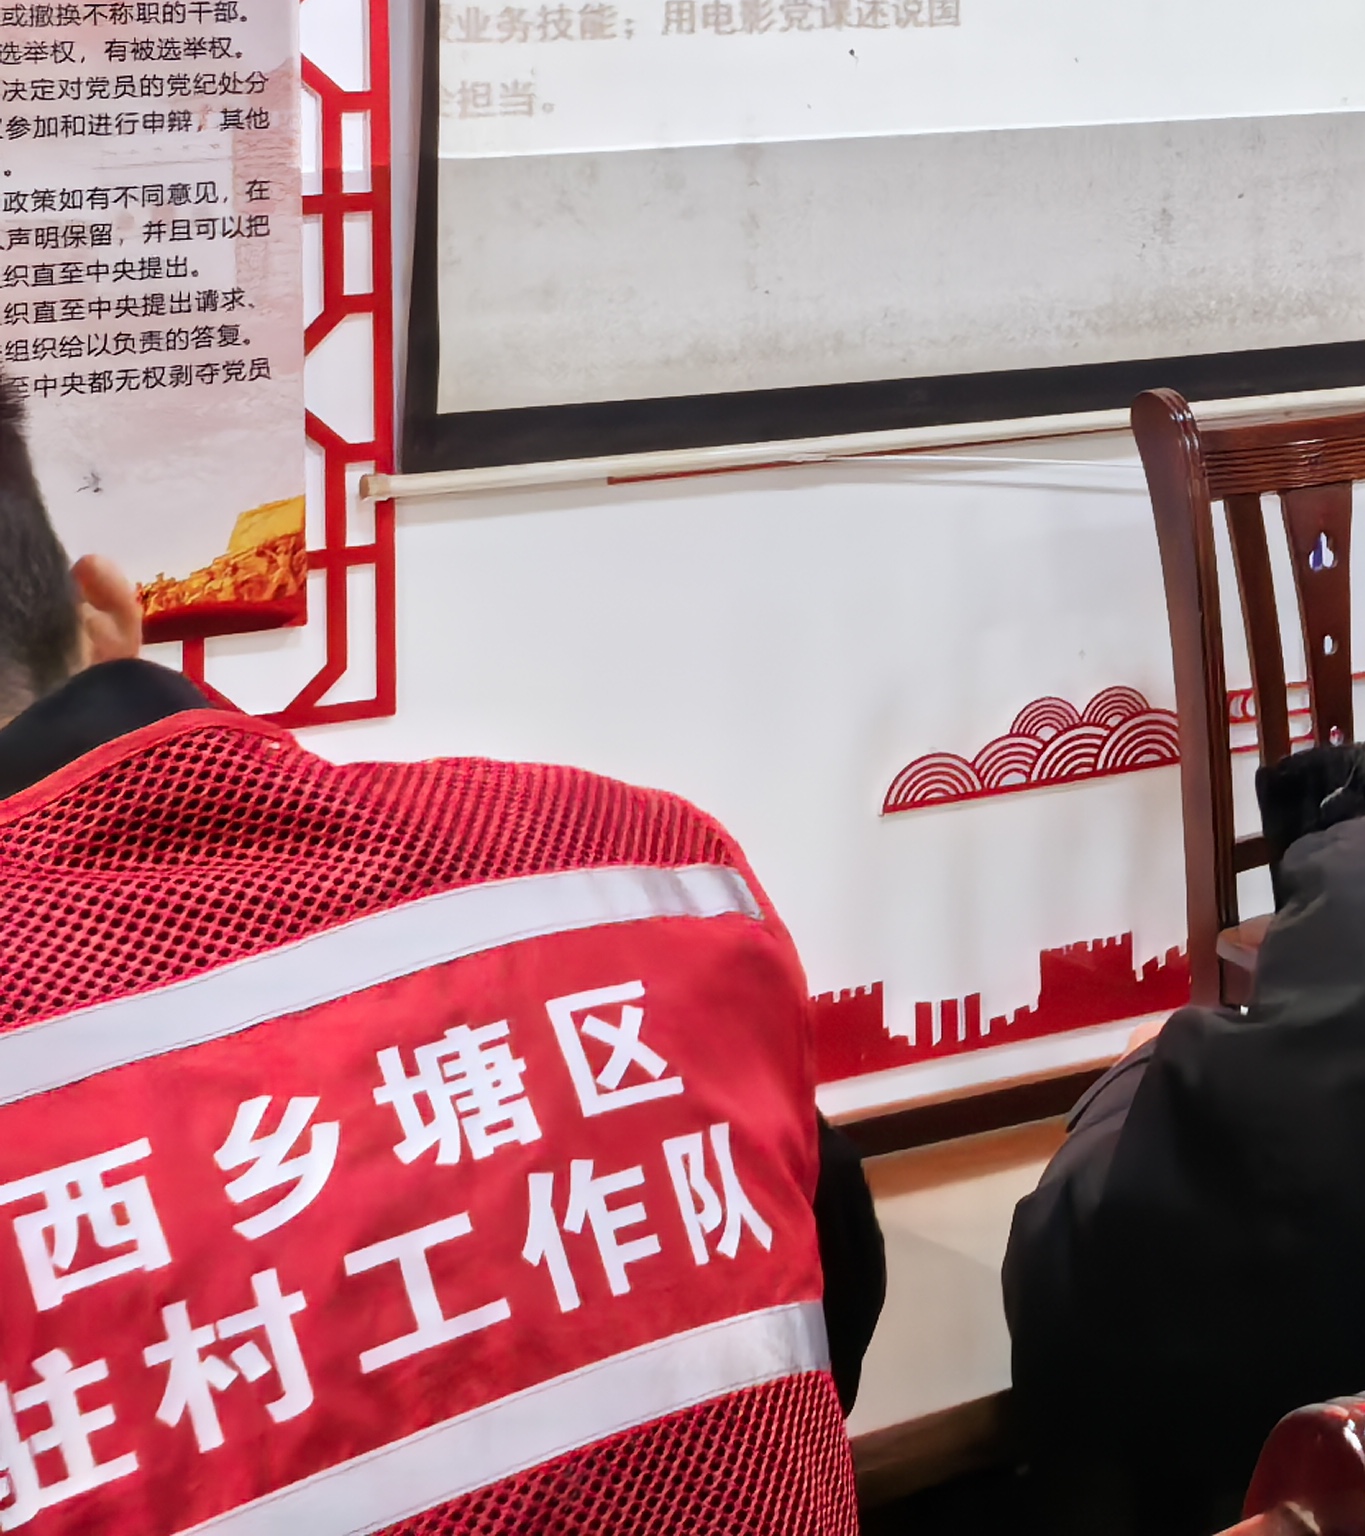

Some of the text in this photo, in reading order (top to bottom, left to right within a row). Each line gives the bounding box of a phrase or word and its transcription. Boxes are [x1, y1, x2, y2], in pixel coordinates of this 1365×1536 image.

[0, 107, 271, 141] 参加和进行申辩，其他
[0, 215, 271, 251] 声明保留，并且可以把
[0, 256, 201, 290] 织直至中央提出。
[0, 287, 257, 326] 织直至中央提出请求、
[0, 323, 253, 364] 组织给以负责的答复。
[0, 979, 684, 1313] 西乡塘区
[0, 1121, 774, 1533] 驻村工作队
